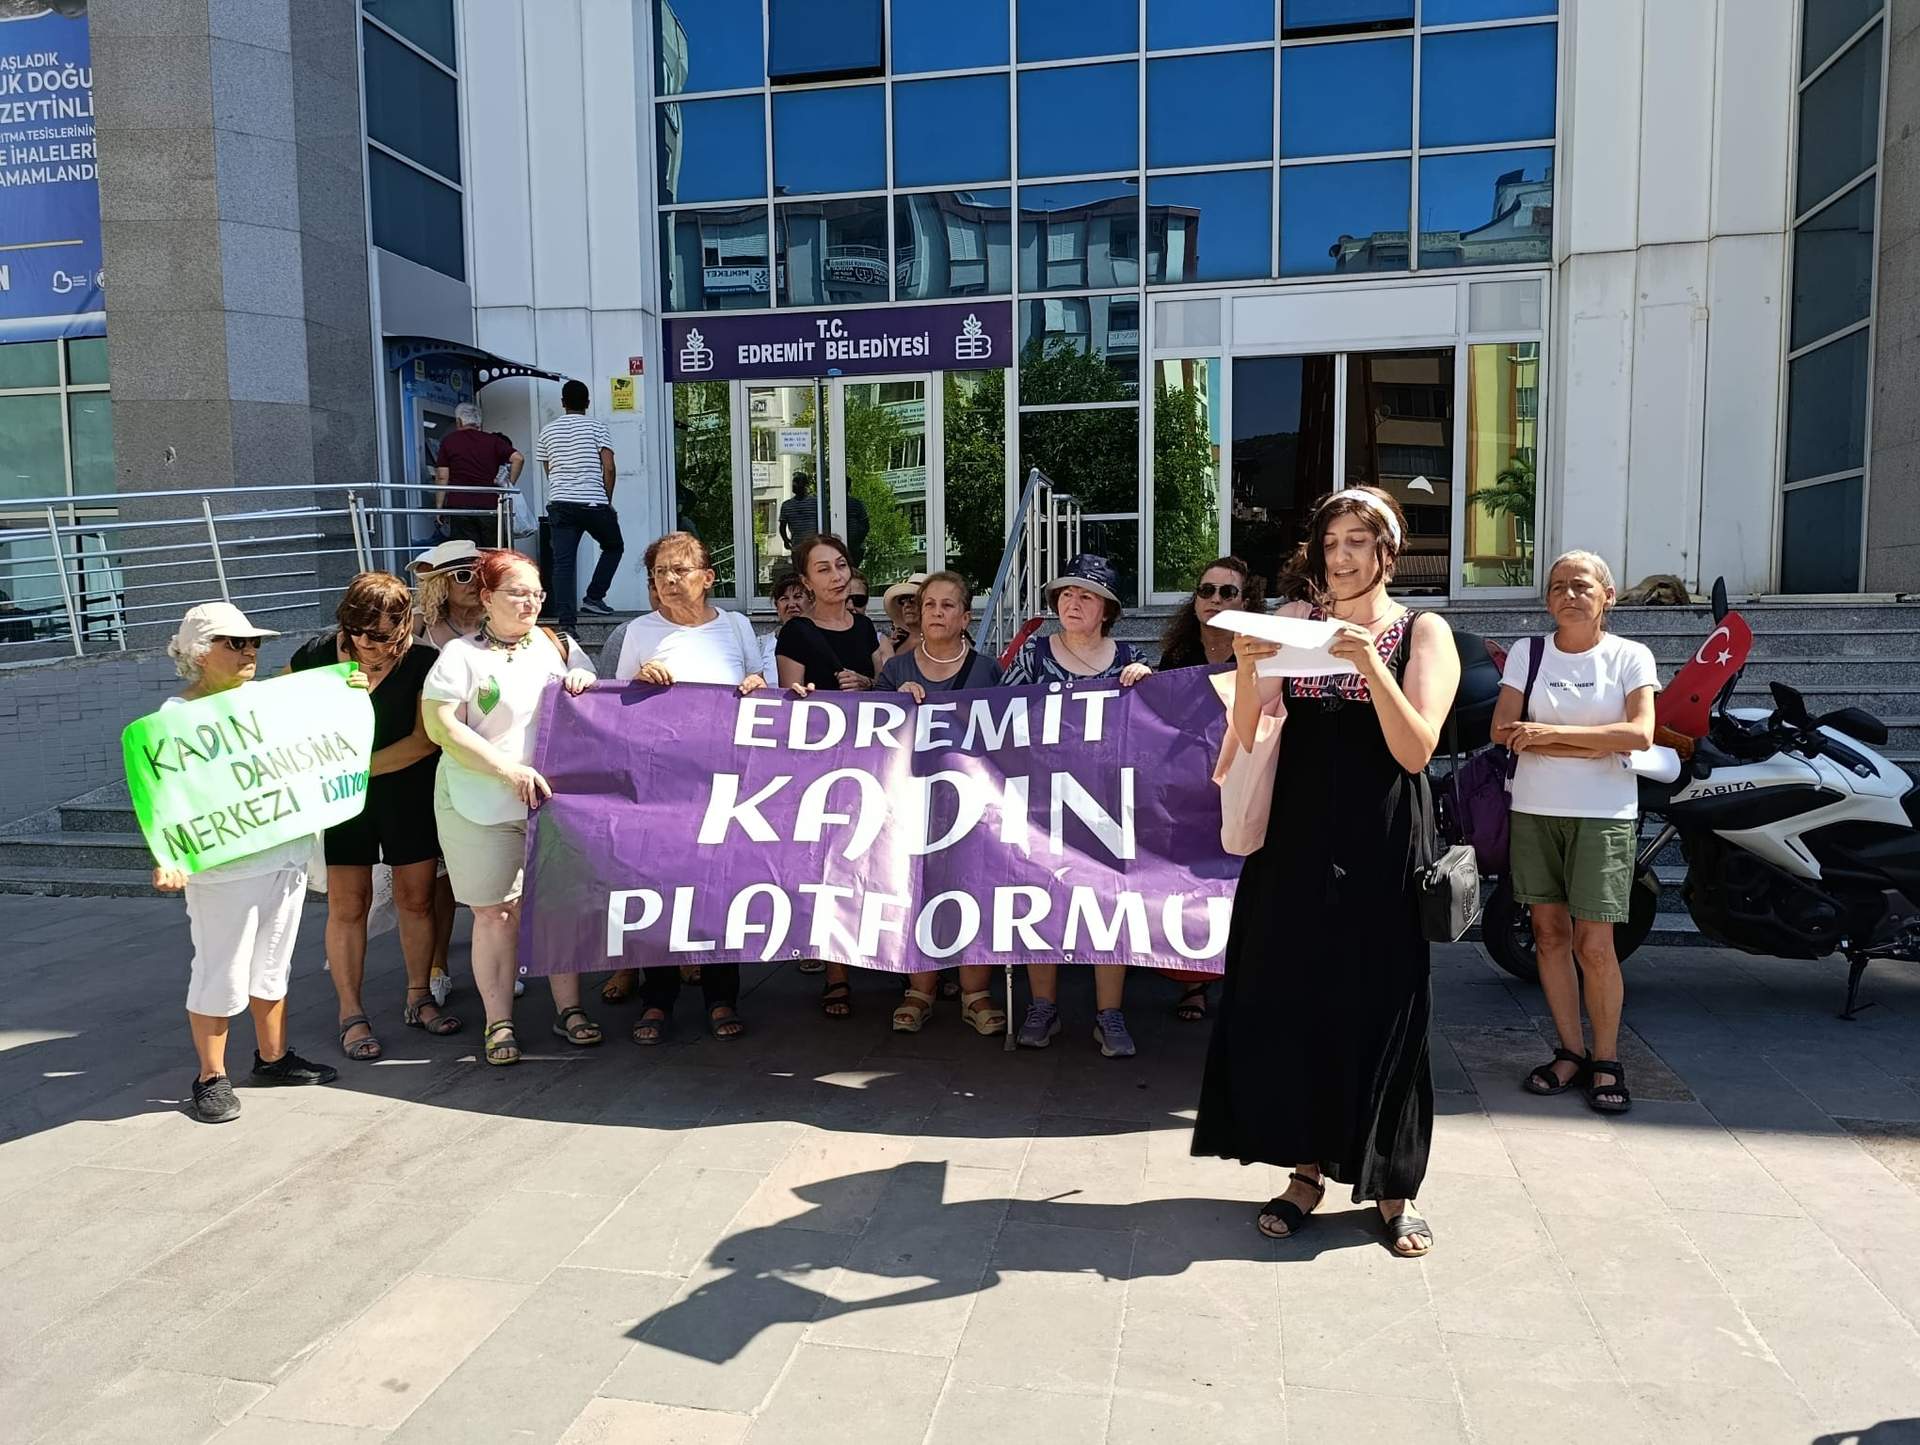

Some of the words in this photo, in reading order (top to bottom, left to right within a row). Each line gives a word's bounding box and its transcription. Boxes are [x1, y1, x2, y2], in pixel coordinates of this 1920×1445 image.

[1, 52, 59, 74] AŞLADIK
[28, 63, 93, 93] DOĞU
[0, 91, 94, 124] ZEYTİNLİ
[11, 138, 97, 165] İHALELERİ
[816, 318, 849, 339] T.C.
[738, 338, 816, 364] EDREMİT
[825, 331, 930, 360] BELEDİYESİ
[734, 681, 1120, 753] EDREMİT
[143, 710, 263, 780] KADIN
[1690, 781, 1756, 798] ZABITA
[162, 783, 301, 861] MERKEZİ
[697, 767, 1136, 861] KADIN
[607, 882, 1234, 962] PLATFORMU
